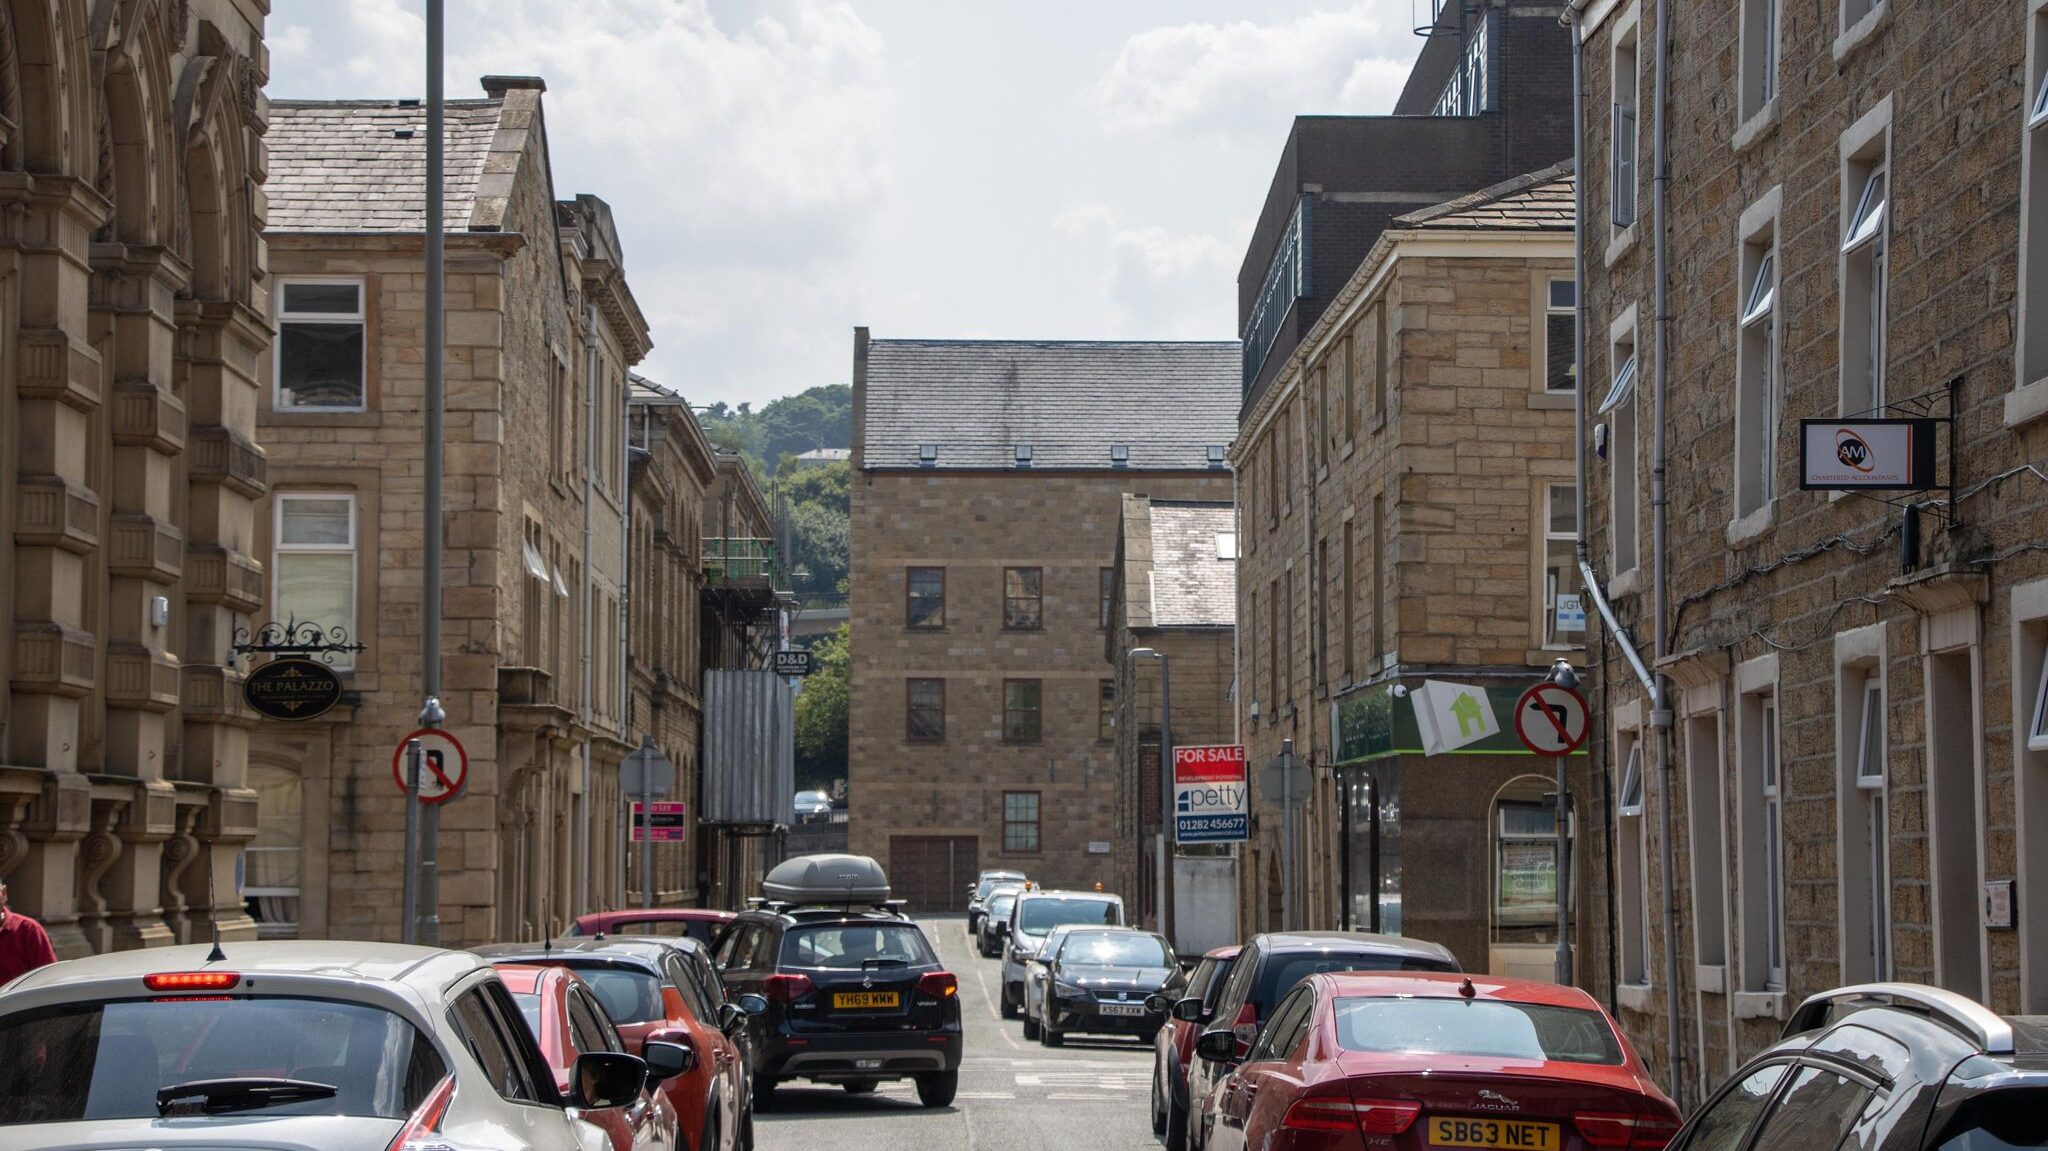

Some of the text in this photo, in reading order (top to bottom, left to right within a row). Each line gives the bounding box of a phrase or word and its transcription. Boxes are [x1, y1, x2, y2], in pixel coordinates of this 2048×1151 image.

[1840, 446, 1864, 459] AM
[777, 653, 808, 664] D&D
[251, 681, 334, 695] THE PALAZZO
[1176, 748, 1243, 763] FOR SALE
[1191, 784, 1245, 812] petty
[1179, 818, 1244, 830] 01282 456677
[840, 995, 869, 1005] YH69
[1103, 1006, 1123, 1015] KS67
[1473, 1103, 1520, 1111] JAGUAR
[1439, 1120, 1550, 1147] SB63 NET
[1368, 1138, 1392, 1146] XE
